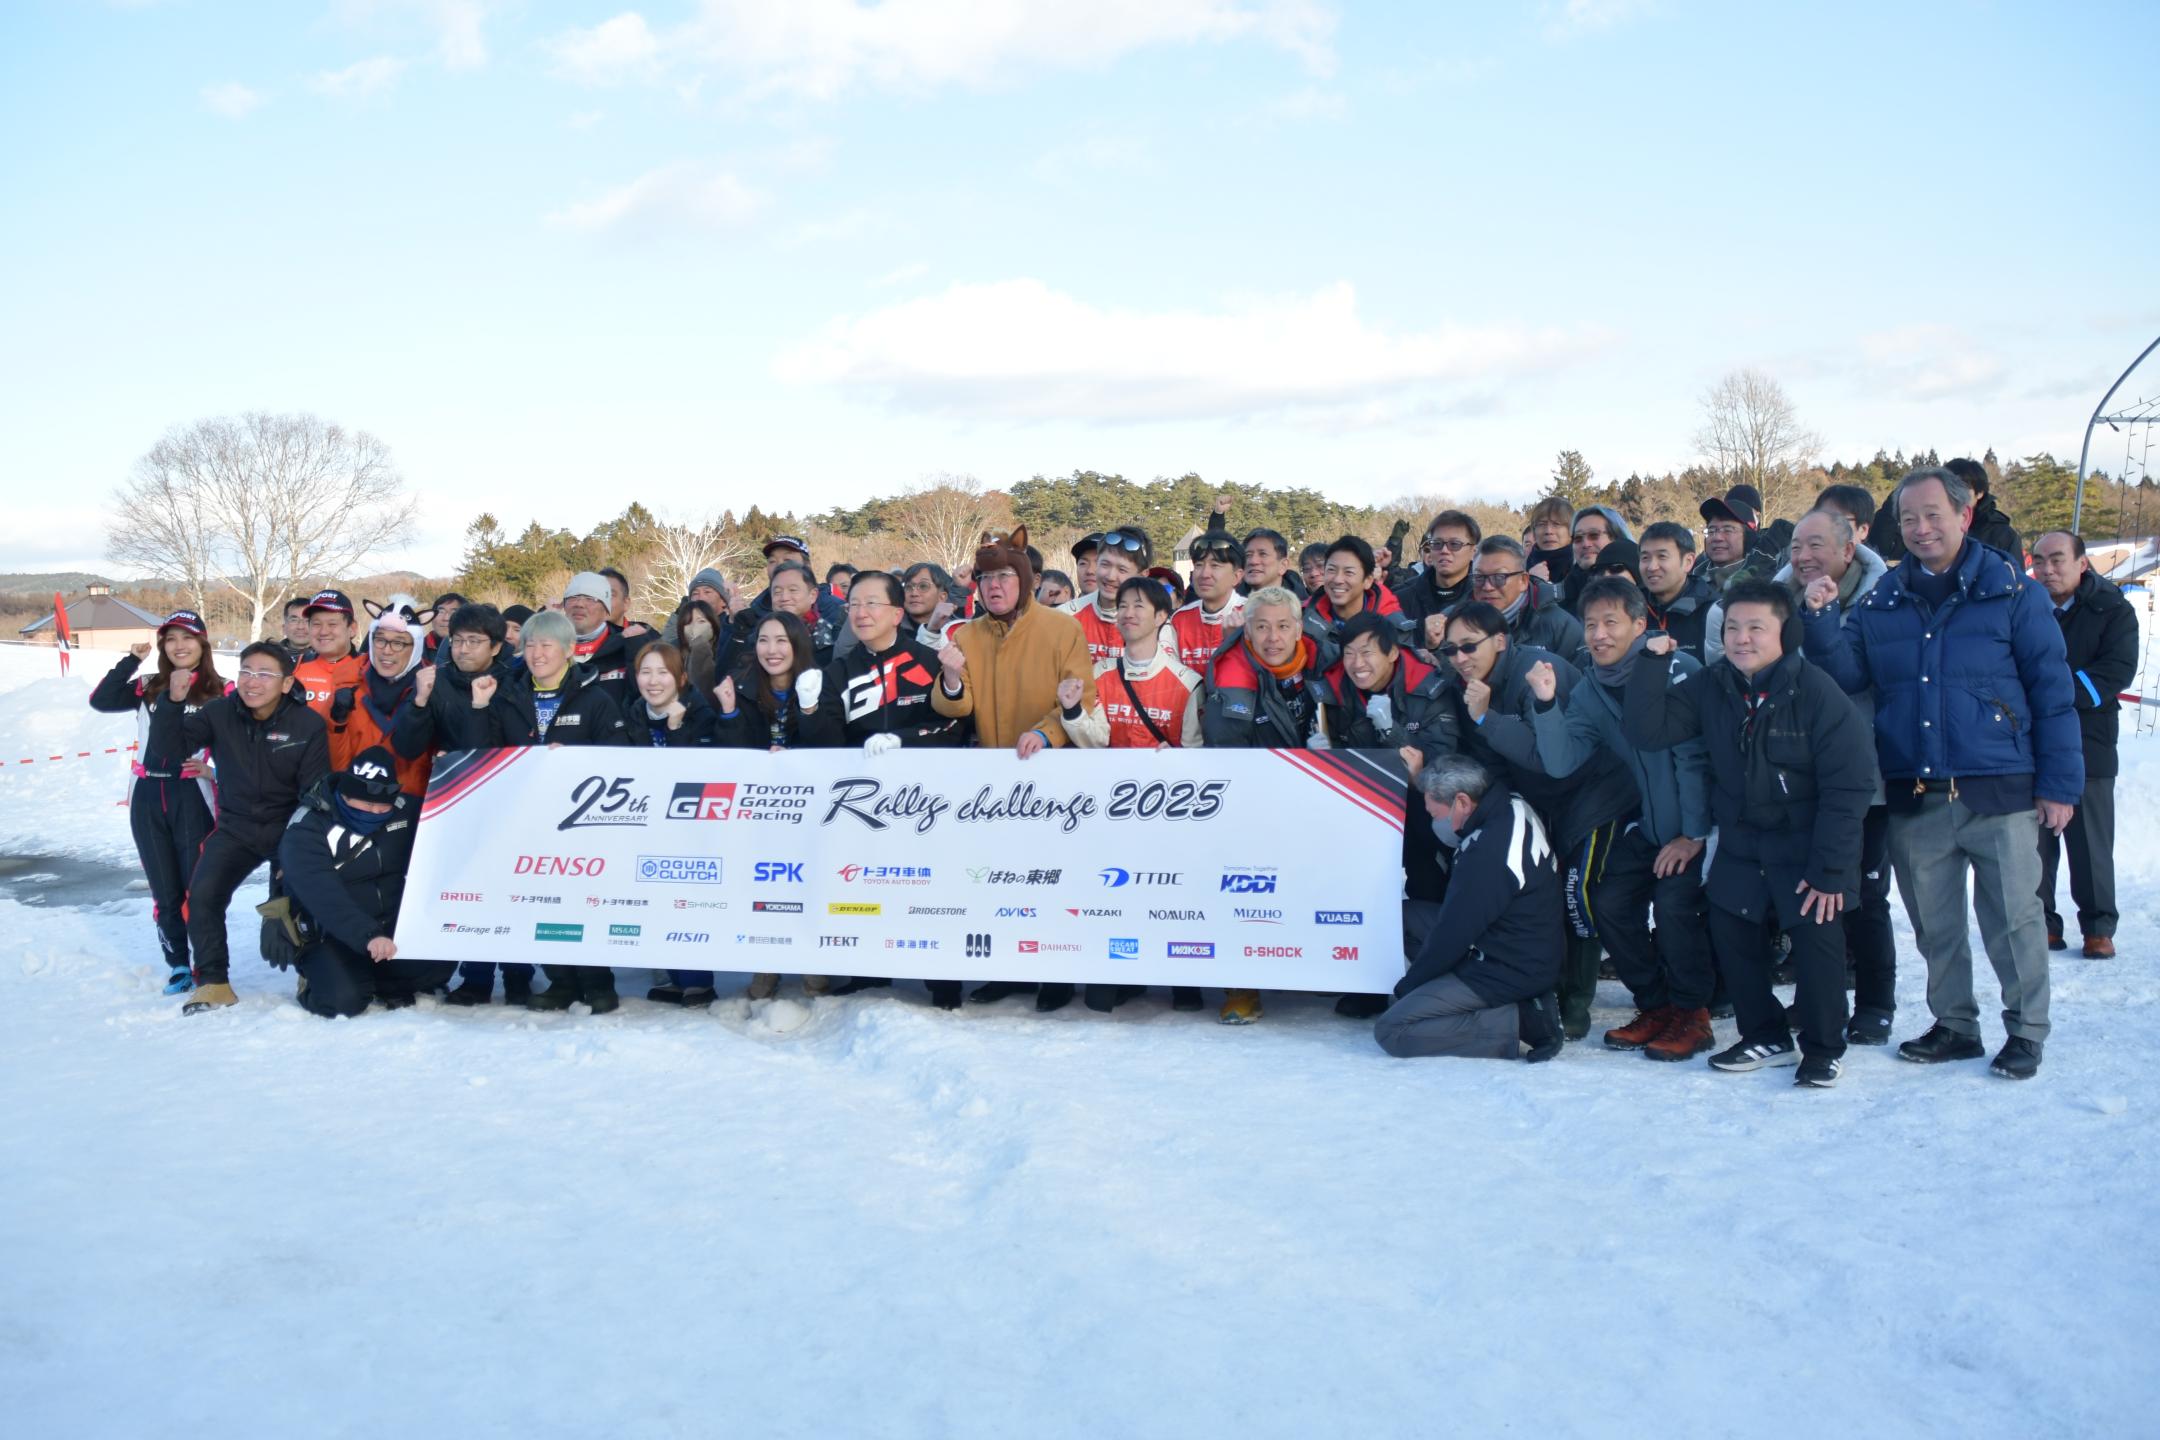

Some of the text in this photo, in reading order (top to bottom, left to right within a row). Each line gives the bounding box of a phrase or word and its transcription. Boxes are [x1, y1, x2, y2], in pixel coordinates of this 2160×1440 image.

[666, 796, 730, 820] GR
[820, 776, 1231, 834] Rally challenge 2025
[736, 809, 804, 825] Racing
[513, 855, 606, 877] DENSO
[660, 859, 718, 871] OGURA
[660, 870, 718, 882] CLUTCH
[753, 862, 805, 883] SPK
[863, 866, 932, 878] トヨタ車体
[987, 868, 1063, 886] ばねの東郷
[1132, 872, 1185, 886] TTDC
[1220, 874, 1278, 893] KDDI
[440, 892, 484, 902] BRIDE
[687, 901, 728, 910] SHINKO
[764, 903, 802, 912] YOKOHAMA
[839, 905, 878, 913] DUNLOP
[908, 906, 967, 916] BRIDGESTONE
[994, 907, 1038, 918] ADVICS
[1082, 909, 1122, 917] YAZAKI
[1148, 909, 1206, 921] NOMURA
[1233, 908, 1282, 919] MIZUHO
[1318, 913, 1360, 923] YUASA
[457, 925, 491, 935] Garage
[611, 927, 640, 935] MS&AD
[666, 932, 710, 943] AISIN
[819, 936, 860, 948] JTEKT
[896, 939, 940, 949] 東海理化
[1041, 943, 1082, 952] DAIHATSU
[1244, 946, 1303, 958] G-SHOCK
[1332, 946, 1359, 960] 3M
